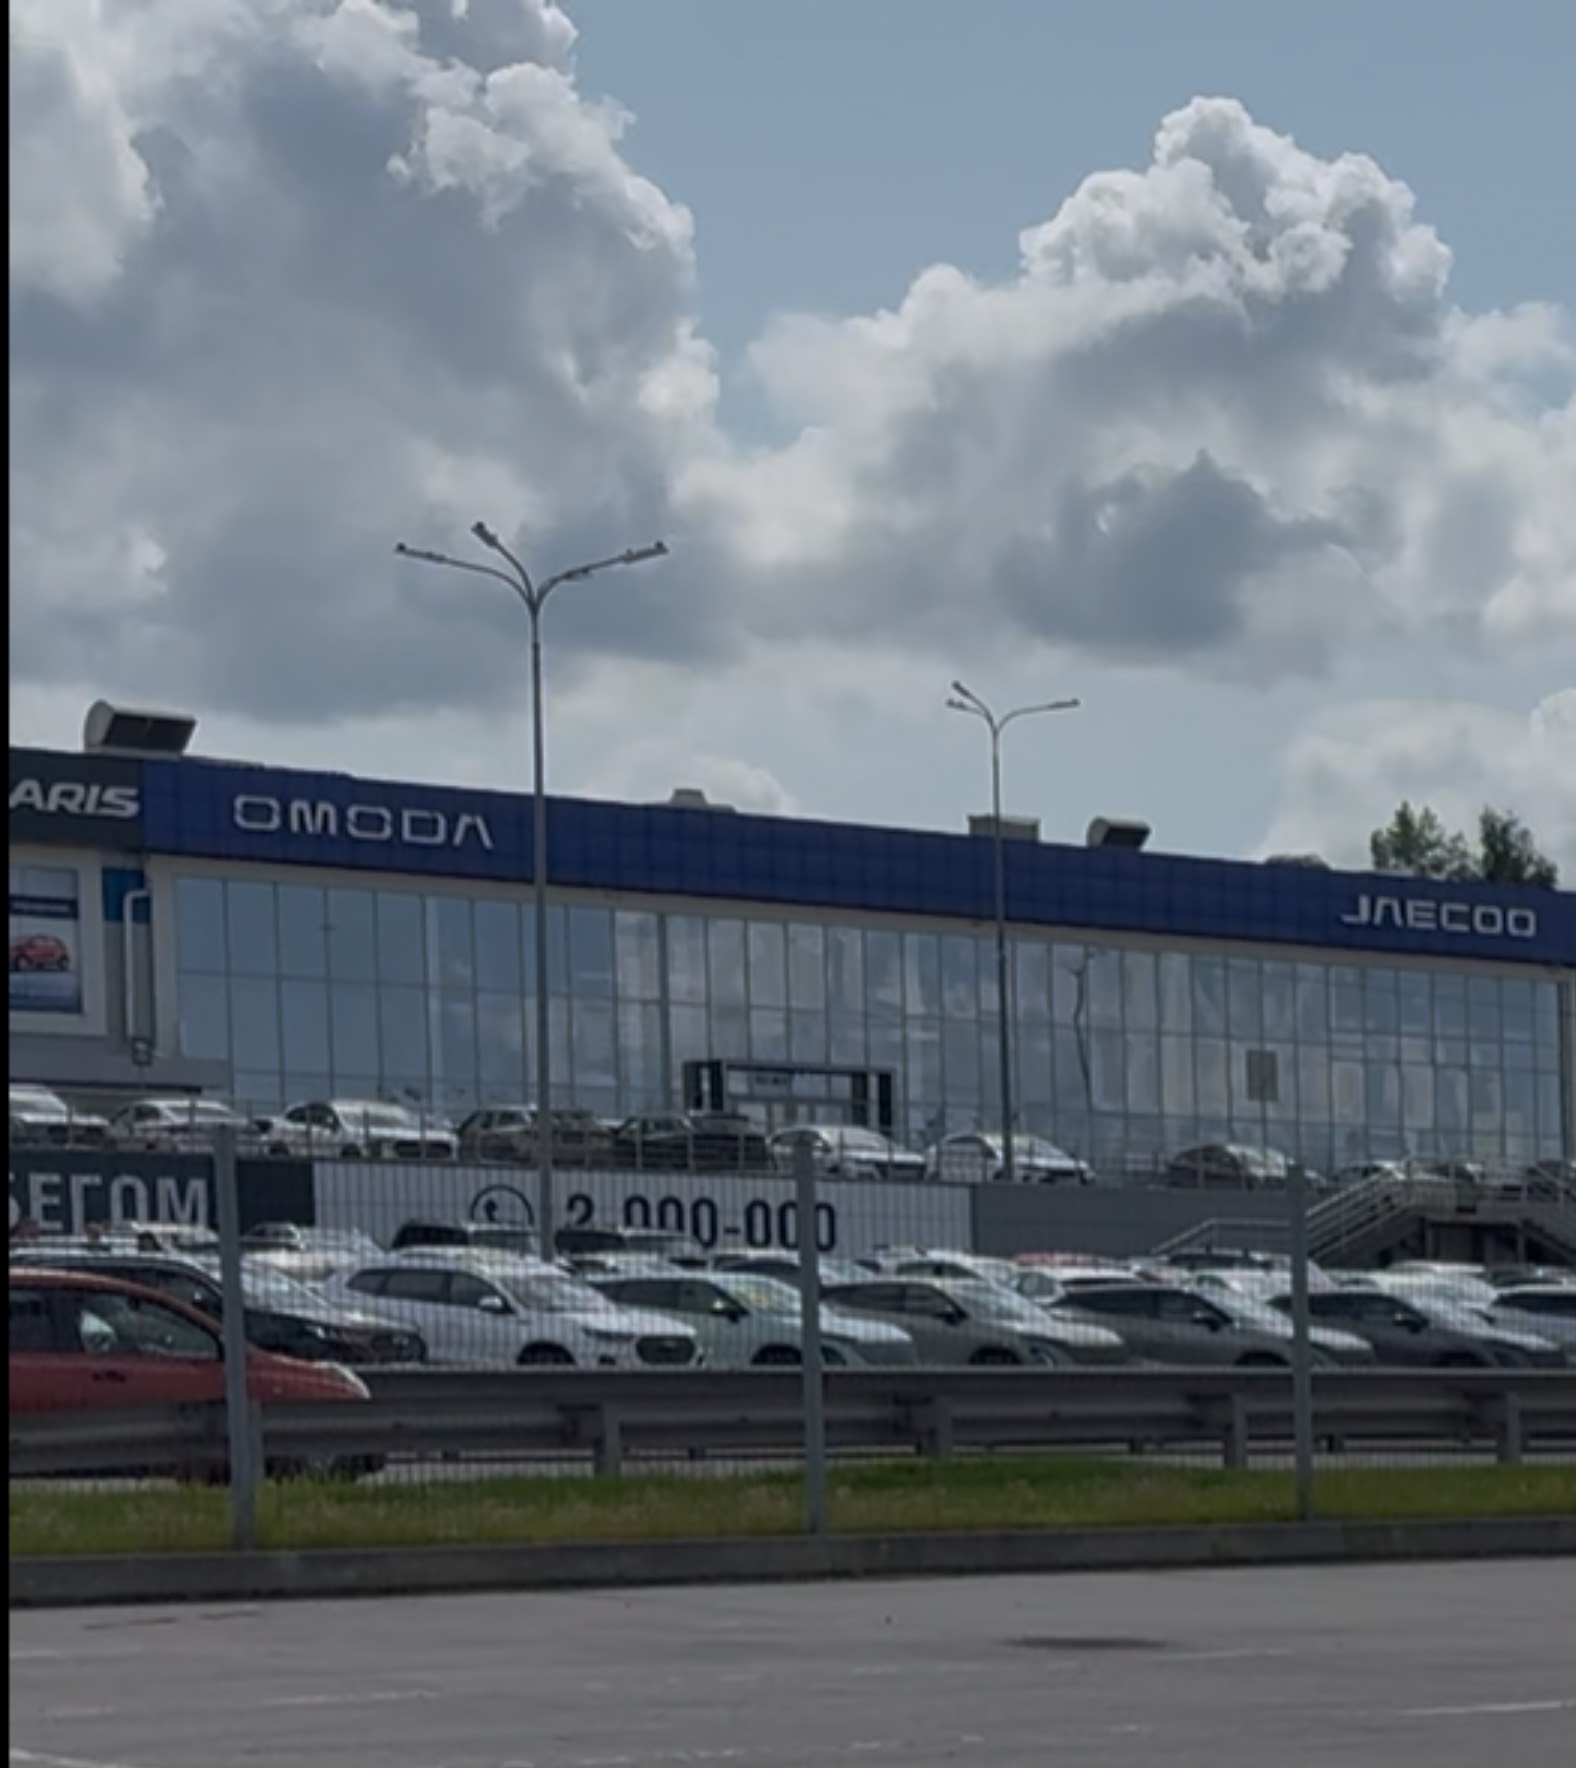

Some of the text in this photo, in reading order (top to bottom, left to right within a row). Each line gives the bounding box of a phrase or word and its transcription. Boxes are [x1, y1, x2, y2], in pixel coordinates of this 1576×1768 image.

[9, 779, 139, 818] ARIS
[234, 794, 493, 849] OMODA
[1341, 894, 1537, 937] JAECOO
